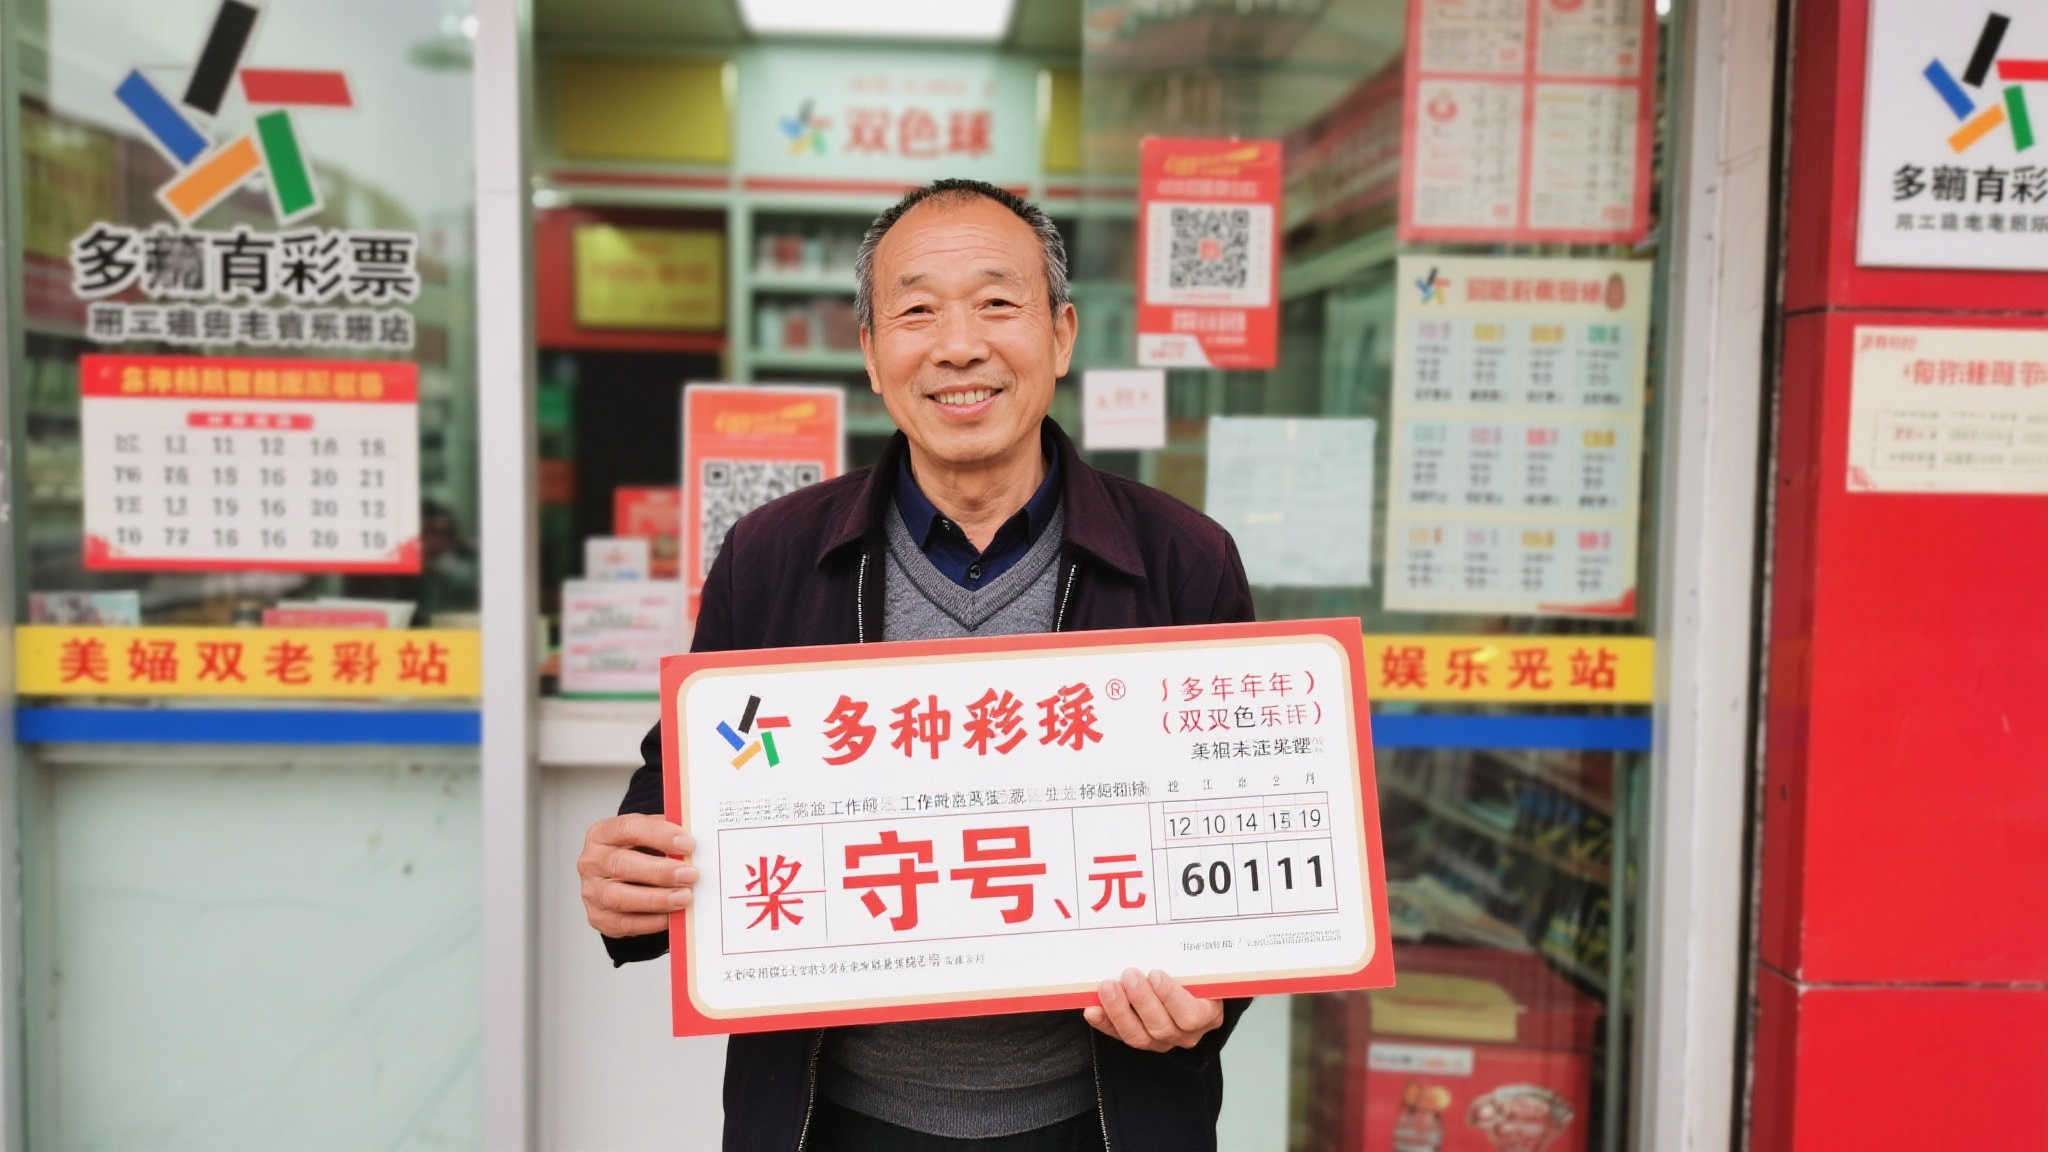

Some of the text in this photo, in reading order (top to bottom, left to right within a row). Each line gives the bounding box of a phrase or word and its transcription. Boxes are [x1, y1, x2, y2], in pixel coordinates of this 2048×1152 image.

[1170, 816, 1191, 837] 12
[1203, 814, 1226, 835] 10
[1236, 812, 1258, 832] 14
[1299, 809, 1321, 829] 19
[1088, 854, 1147, 912] 元
